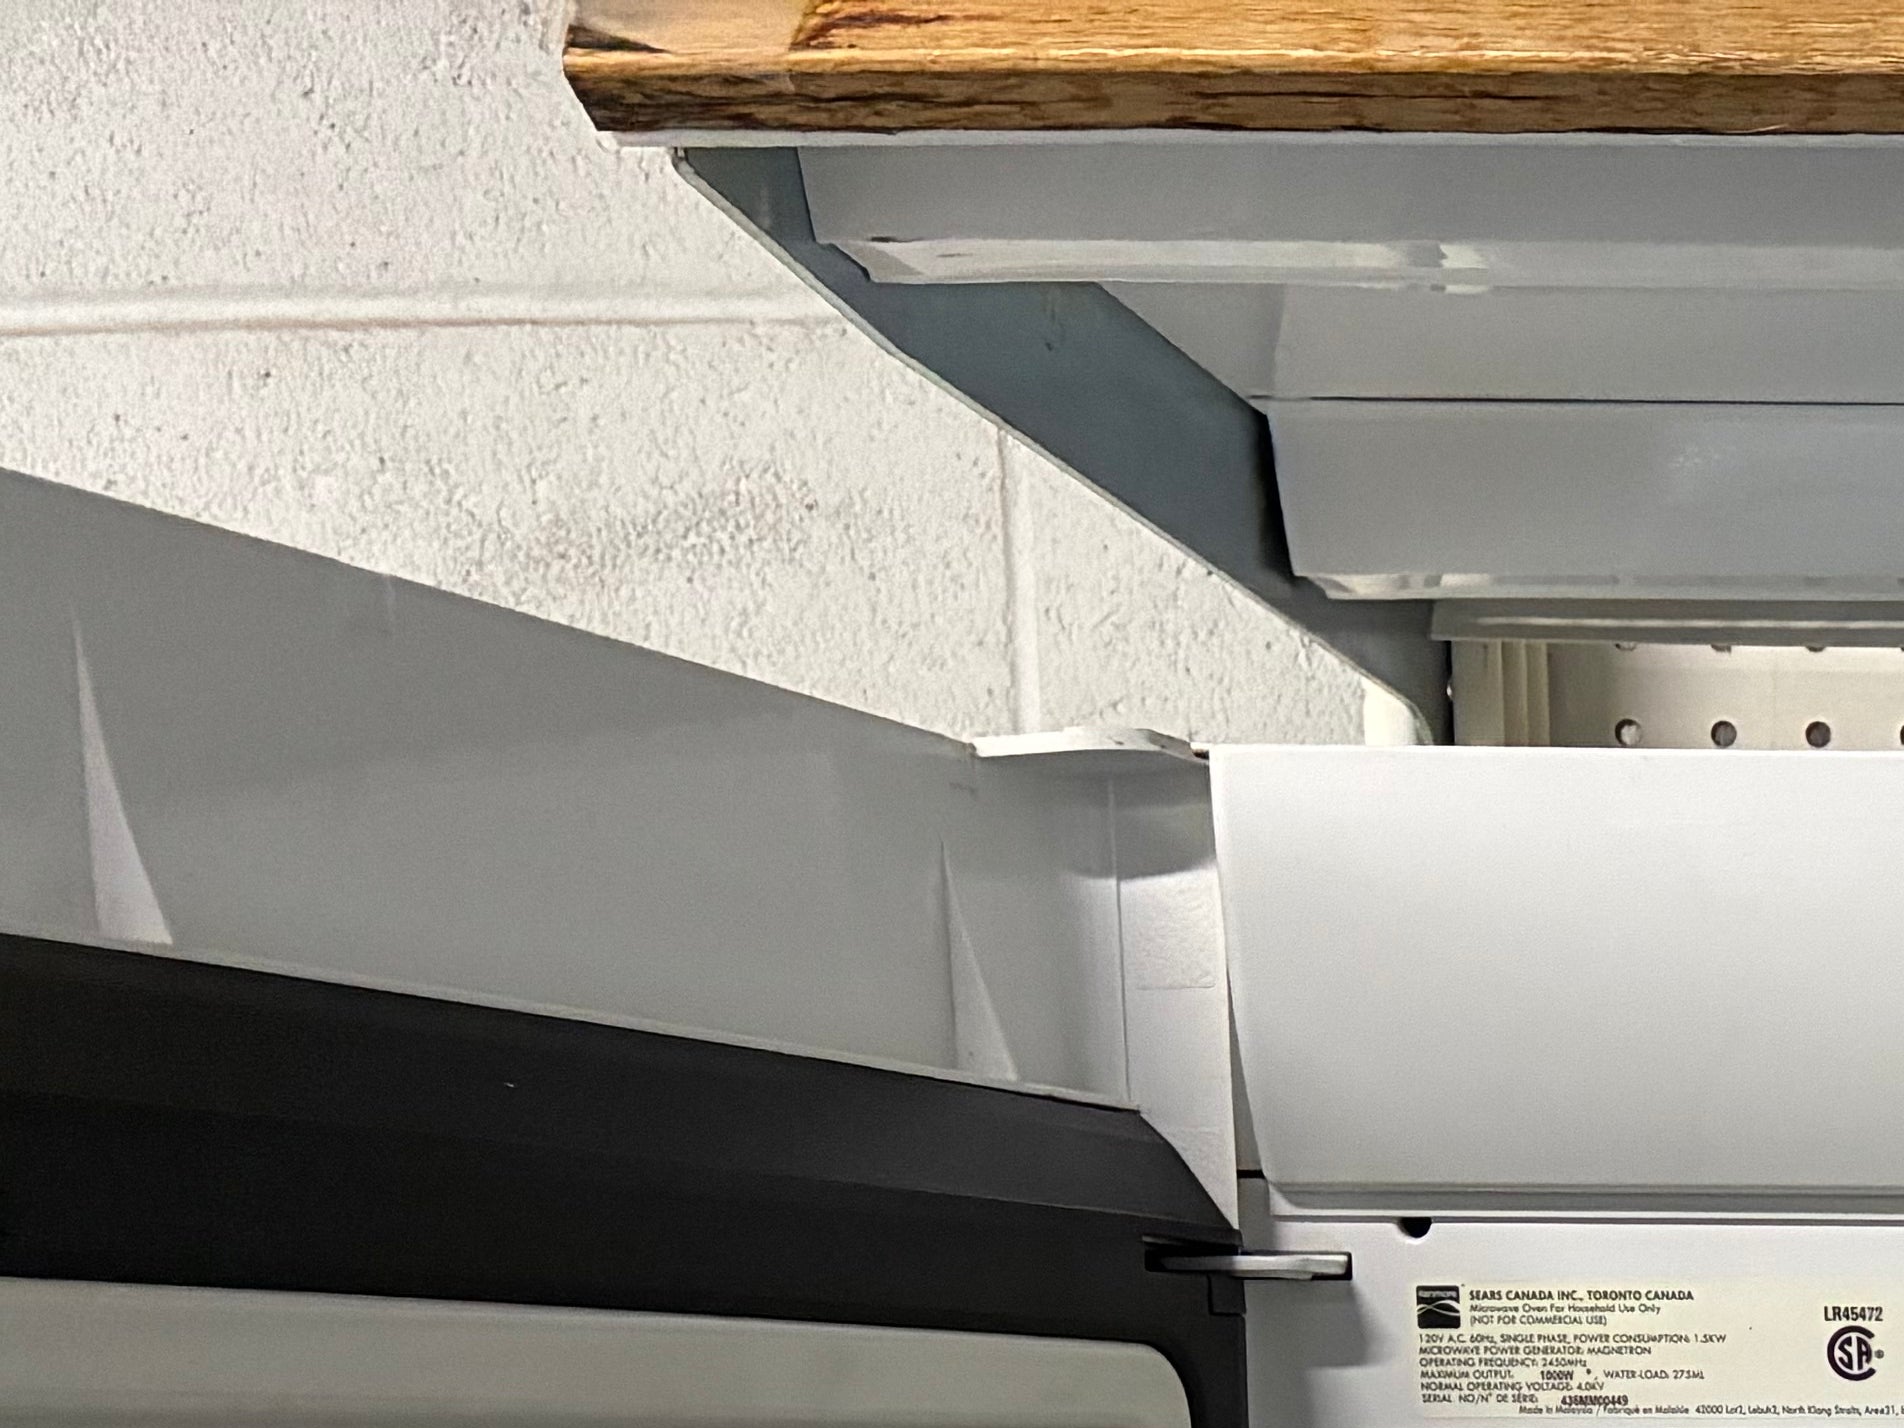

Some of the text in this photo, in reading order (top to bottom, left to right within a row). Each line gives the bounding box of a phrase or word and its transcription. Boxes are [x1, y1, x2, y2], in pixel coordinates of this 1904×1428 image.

[1469, 1290, 1502, 1300] SEARS
[1506, 1290, 1554, 1300] CANADA
[1587, 1290, 1642, 1301] TORONTO
[1645, 1290, 1694, 1301] CANADA
[1824, 1306, 1883, 1321] LR45472
